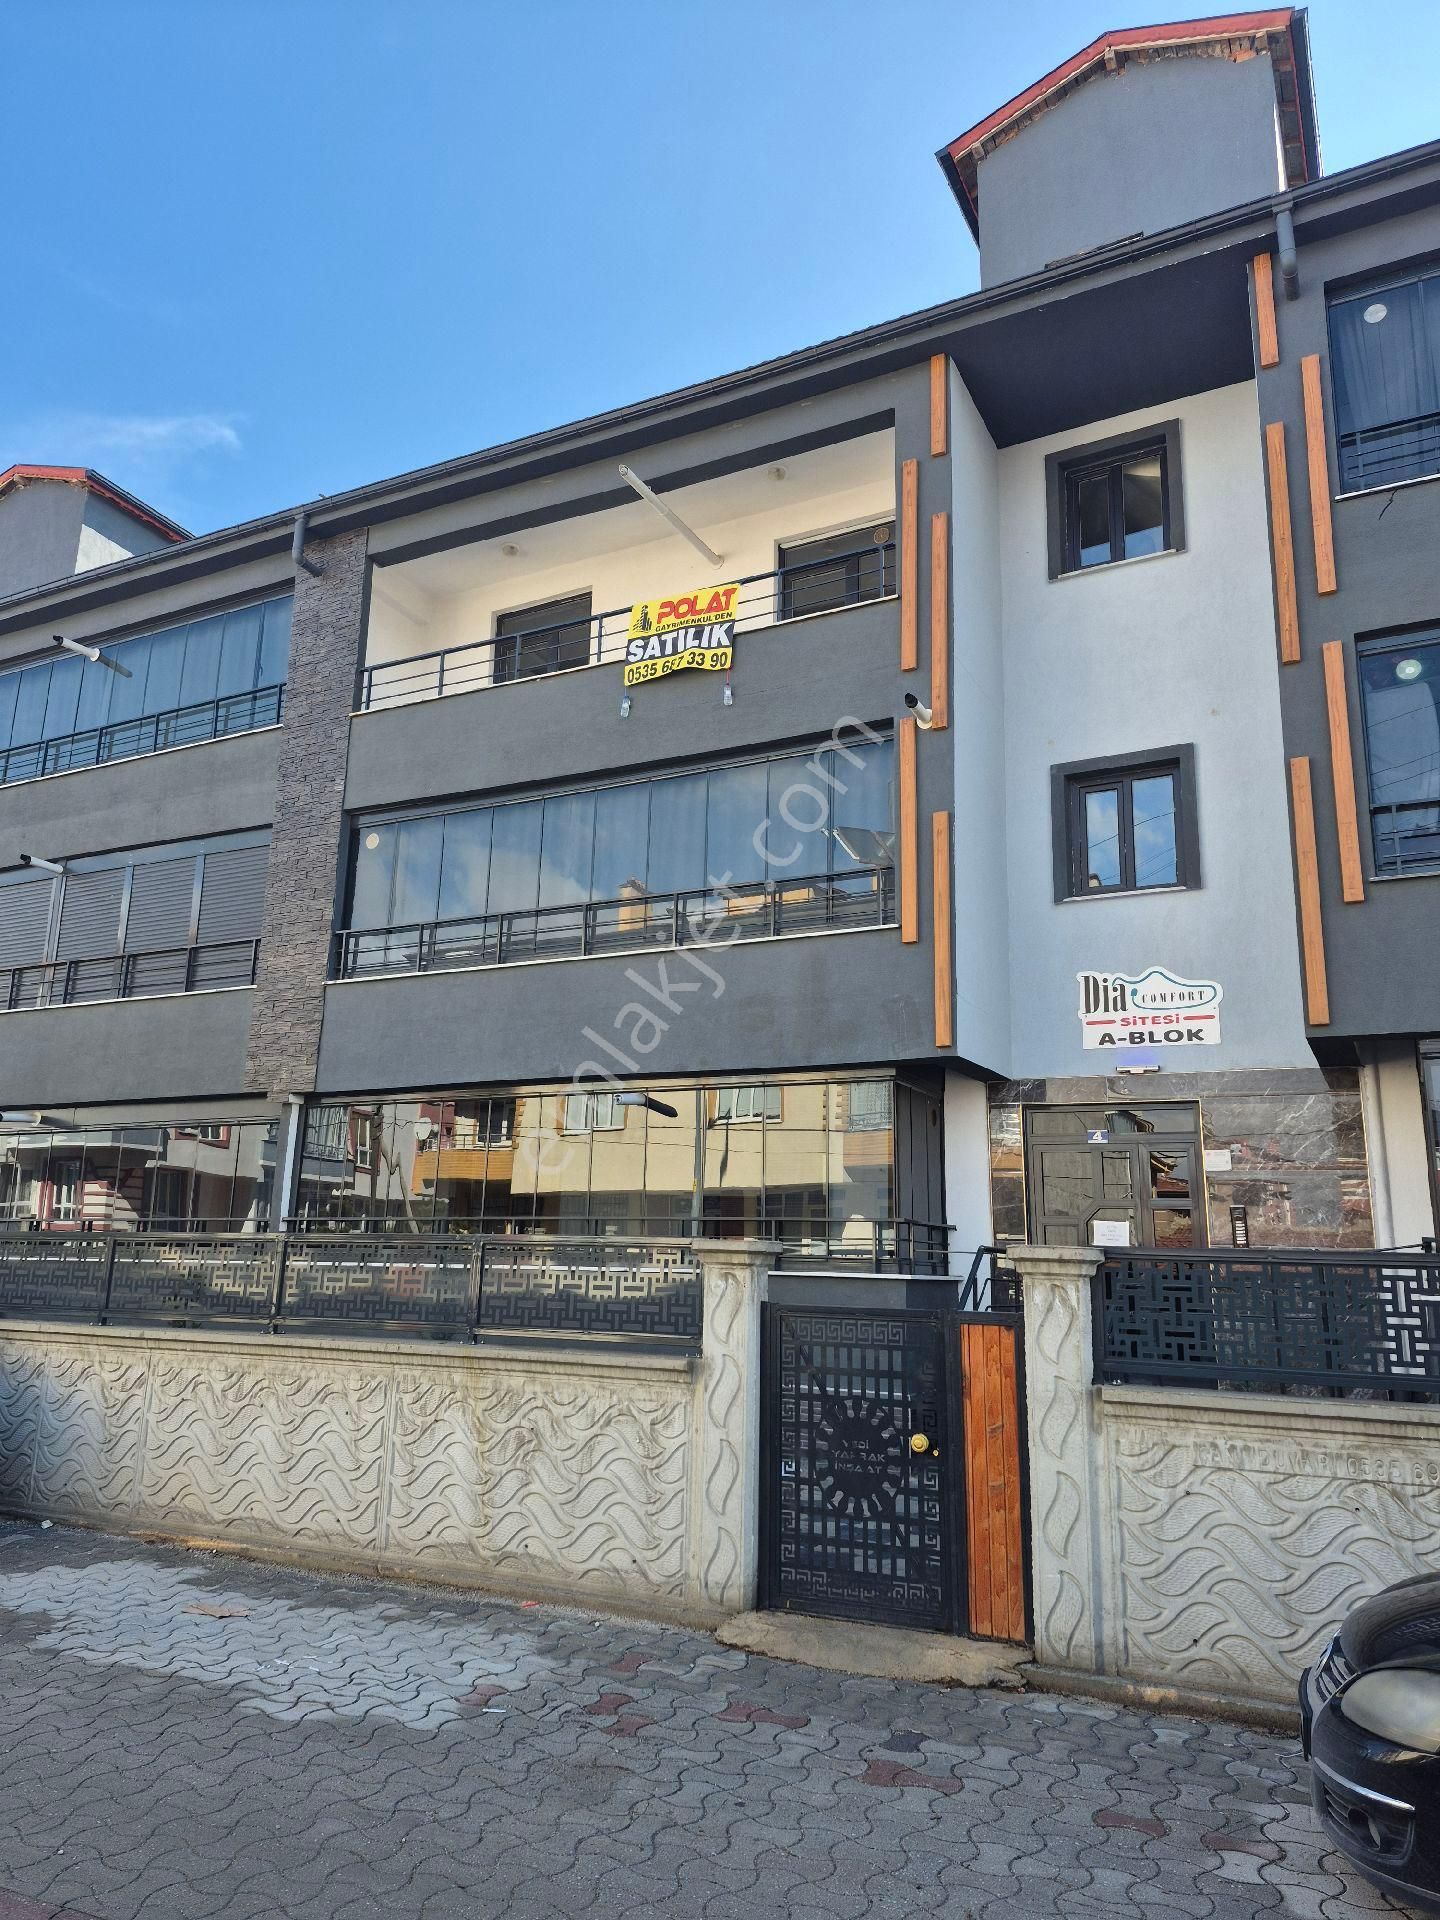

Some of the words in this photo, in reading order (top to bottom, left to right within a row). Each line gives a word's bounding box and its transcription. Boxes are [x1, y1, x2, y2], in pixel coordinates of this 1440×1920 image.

[656, 588, 737, 624] POLAT
[627, 622, 732, 662] SATILIK
[627, 663, 658, 684] 0535
[686, 651, 706, 666] 33
[709, 651, 729, 669] 90
[1081, 975, 1128, 1015] Dia
[1098, 1028, 1205, 1046] A-BLOK
[1092, 1131, 1102, 1141] 4
